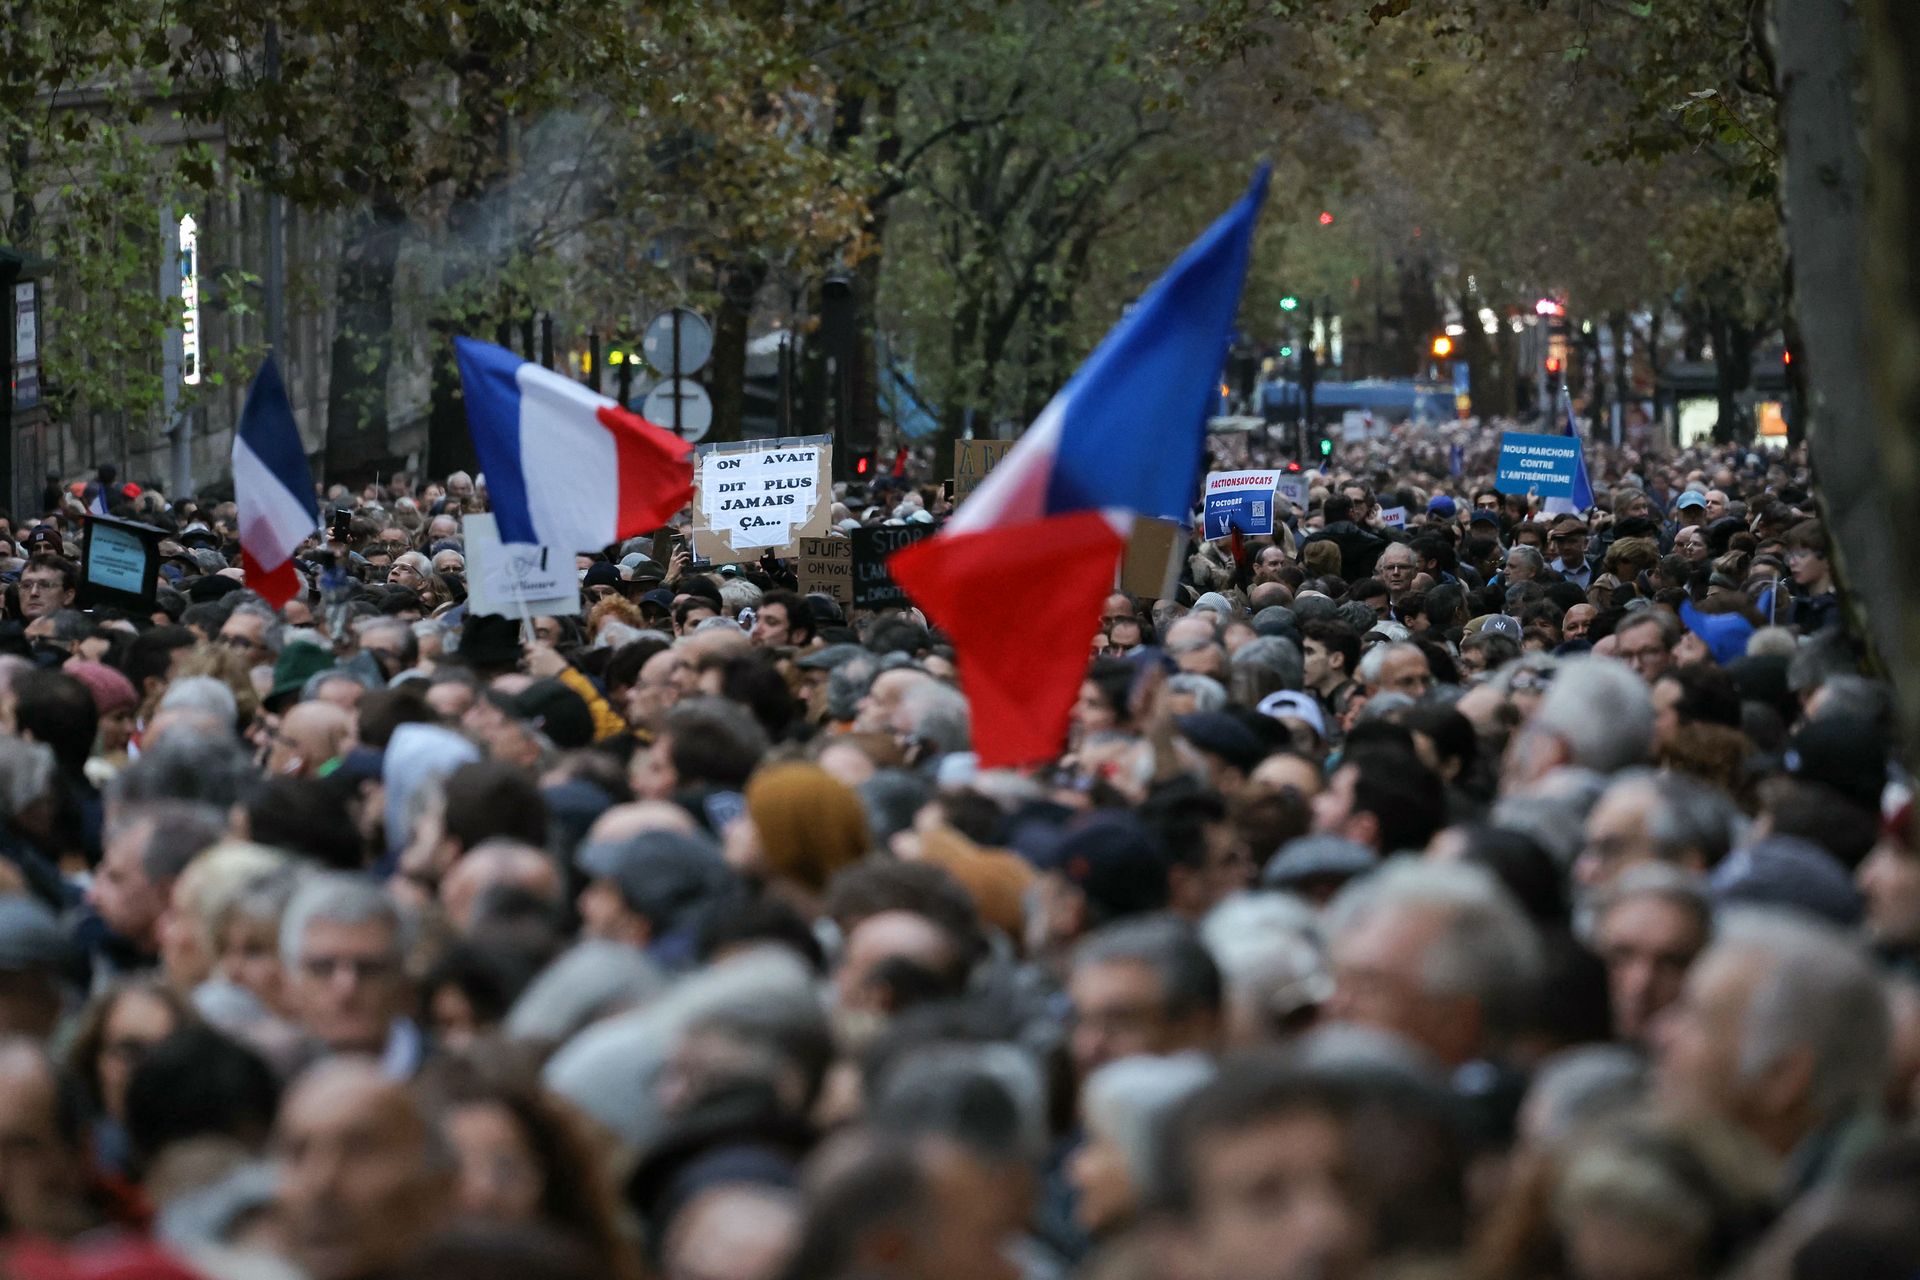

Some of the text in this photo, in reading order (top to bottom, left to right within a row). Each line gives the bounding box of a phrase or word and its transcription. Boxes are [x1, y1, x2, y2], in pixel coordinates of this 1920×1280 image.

[1503, 445, 1575, 458] NOUS MARCHONS
[717, 452, 815, 470] ON AVAIT
[1520, 459, 1554, 469] CONTRE
[1211, 476, 1273, 488] #ACTIONSAVOCATS
[1501, 470, 1570, 484] L'ANTISÉMITISME
[719, 477, 812, 492] DIT PLUS
[720, 494, 795, 511] JAMAIS
[1216, 497, 1243, 507] OCTOBRE
[739, 516, 781, 530] ÇA...
[871, 528, 924, 553] STOP
[808, 540, 852, 558] JUIFS
[808, 562, 825, 575] ON
